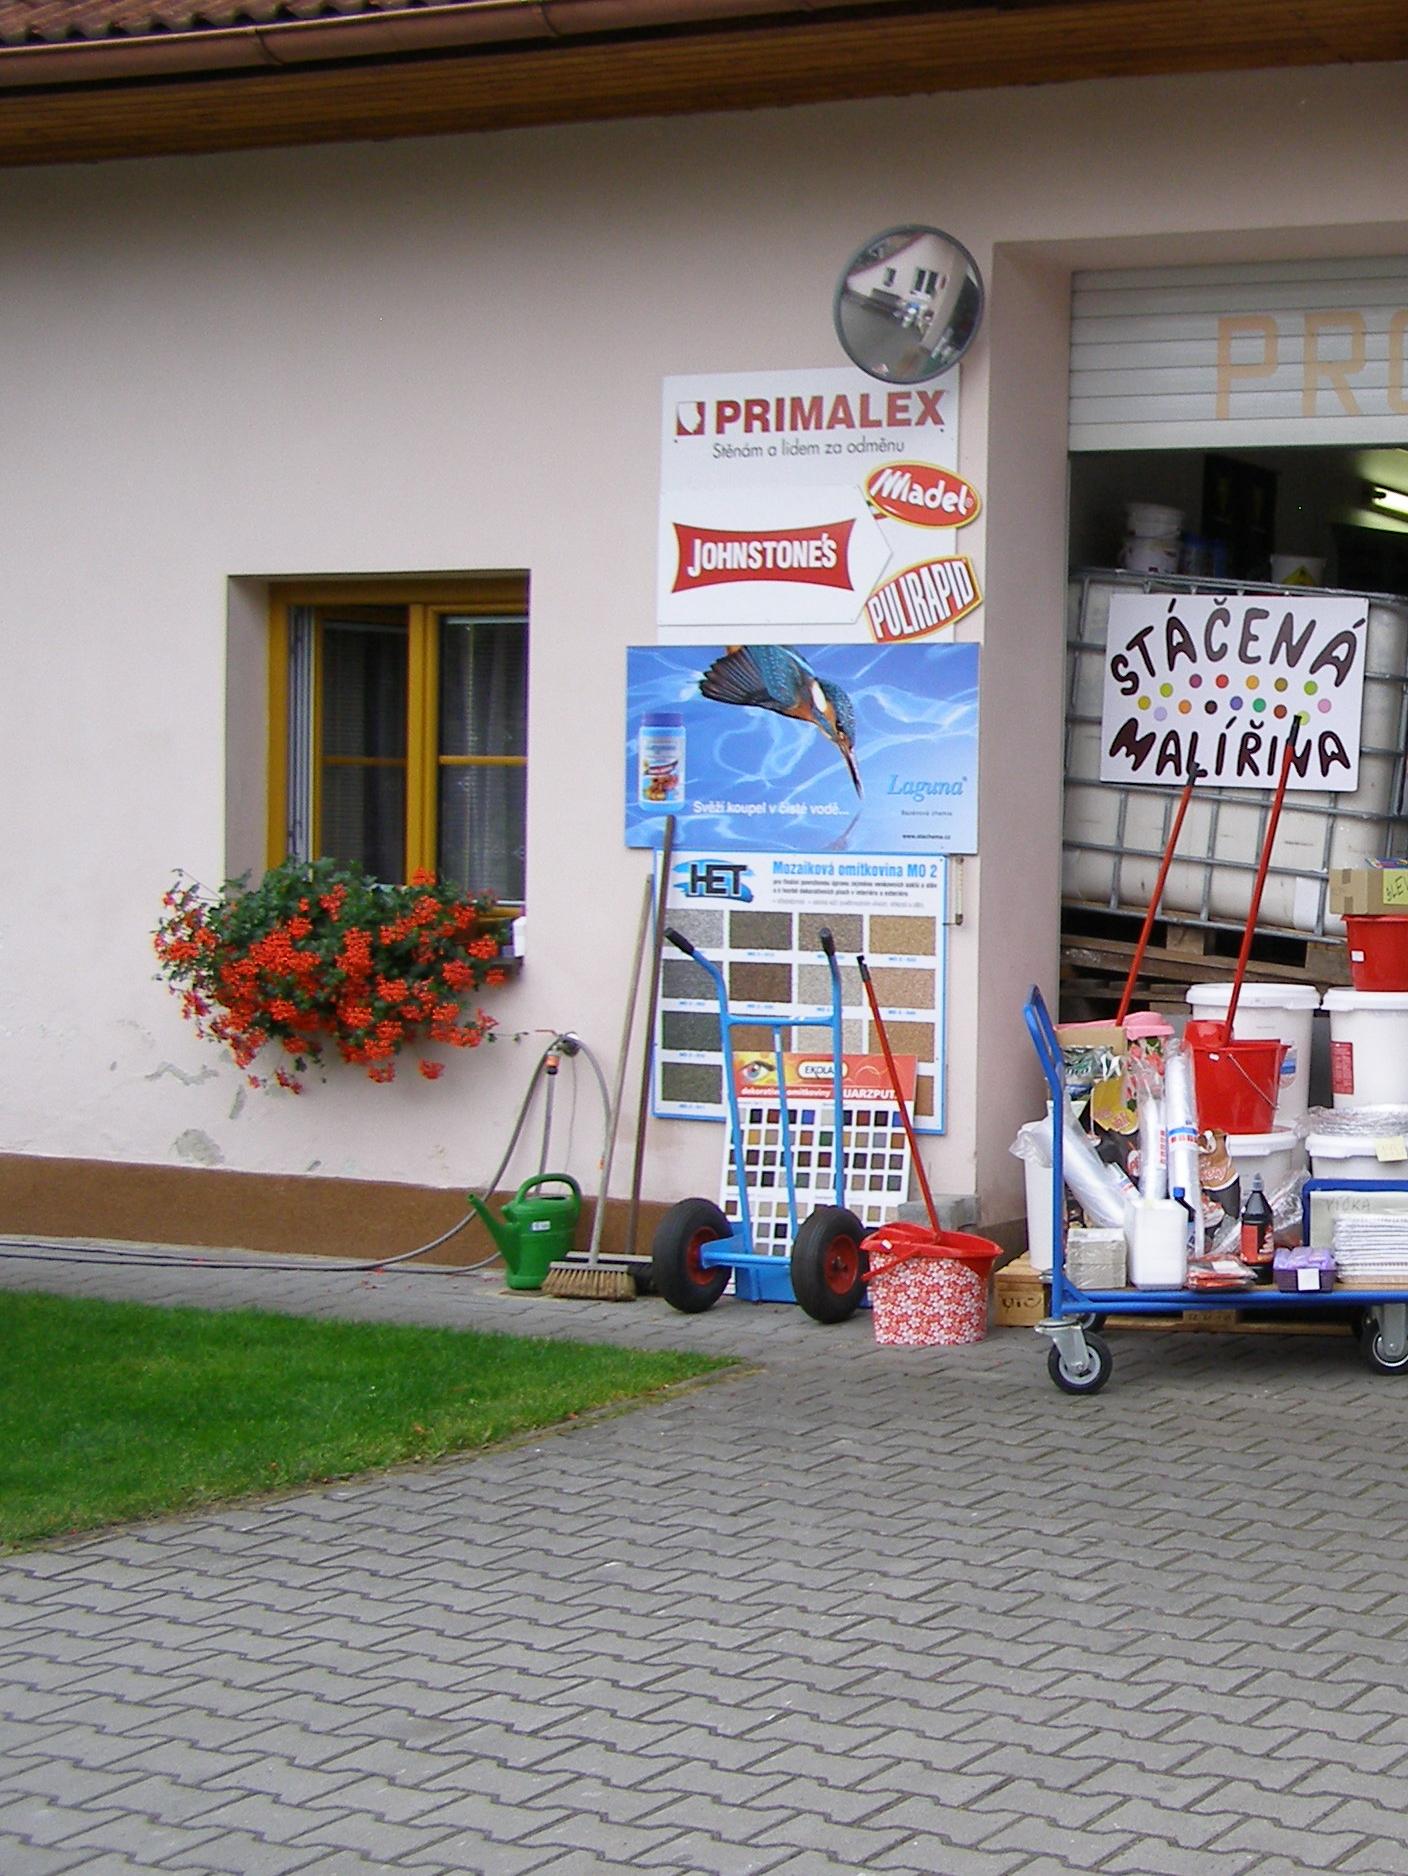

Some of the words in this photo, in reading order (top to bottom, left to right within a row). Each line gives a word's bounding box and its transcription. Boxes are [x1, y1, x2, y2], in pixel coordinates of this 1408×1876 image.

[715, 389, 947, 434] PRIMALEX
[713, 441, 763, 459] Stěnám
[767, 446, 777, 457] a
[824, 443, 842, 455] za
[847, 434, 905, 453] odměnu
[869, 467, 968, 516] Madel
[687, 532, 838, 578] JOHNSTONE'S
[867, 560, 976, 639] PULIRAPID
[1110, 598, 1366, 696] STÁČENÁ
[1109, 716, 1351, 778] MALÍŘINA
[886, 774, 964, 802] Laguna
[726, 800, 766, 817] koupel
[768, 804, 776, 814] v
[690, 863, 749, 897] HET
[772, 860, 835, 877] Mozaiková
[906, 863, 927, 878] MO
[929, 864, 938, 879] 2
[804, 1065, 834, 1076] EKOLA
[842, 1088, 898, 1100] UARZPUT.
